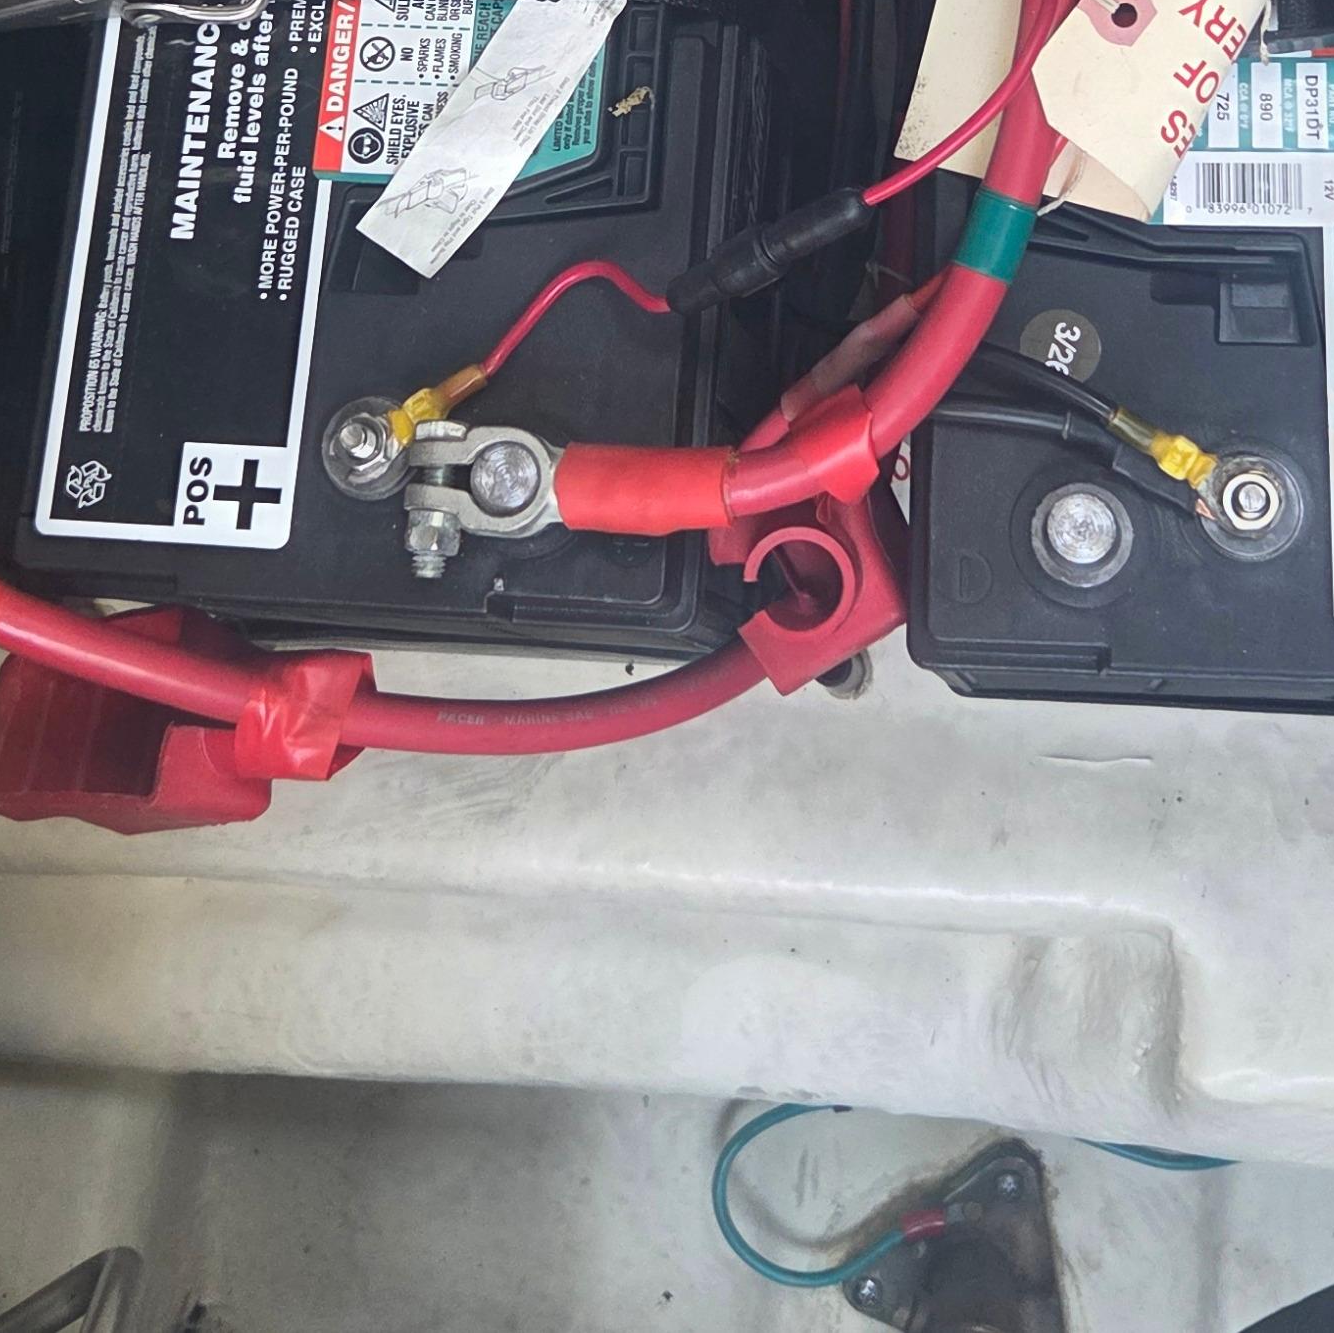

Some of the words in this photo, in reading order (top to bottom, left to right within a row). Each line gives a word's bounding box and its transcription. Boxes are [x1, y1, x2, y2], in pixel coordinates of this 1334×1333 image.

[251, 9, 274, 66] after
[399, 45, 414, 62] NO
[415, 36, 432, 72] SPARKS
[431, 36, 447, 73] FLAMES
[446, 31, 463, 74] SMOKING
[169, 21, 221, 240] MAINTENANC
[216, 62, 246, 159] Remove
[239, 72, 267, 143] levels
[389, 93, 407, 125] EYES.
[1215, 91, 1230, 121] 725
[1258, 92, 1273, 122] 890
[1303, 74, 1321, 141] DP31DT
[264, 66, 299, 234] POWER-PER-POUND
[384, 126, 402, 166] SHIELD
[232, 149, 258, 203] fluid
[286, 165, 307, 213] CASE
[1322, 178, 1334, 201] 12V
[257, 237, 278, 289] MORE
[276, 215, 300, 290] RUGGED
[88, 309, 107, 358] WARNING:
[78, 368, 99, 432] PROPOSITION
[182, 455, 213, 526] POS
